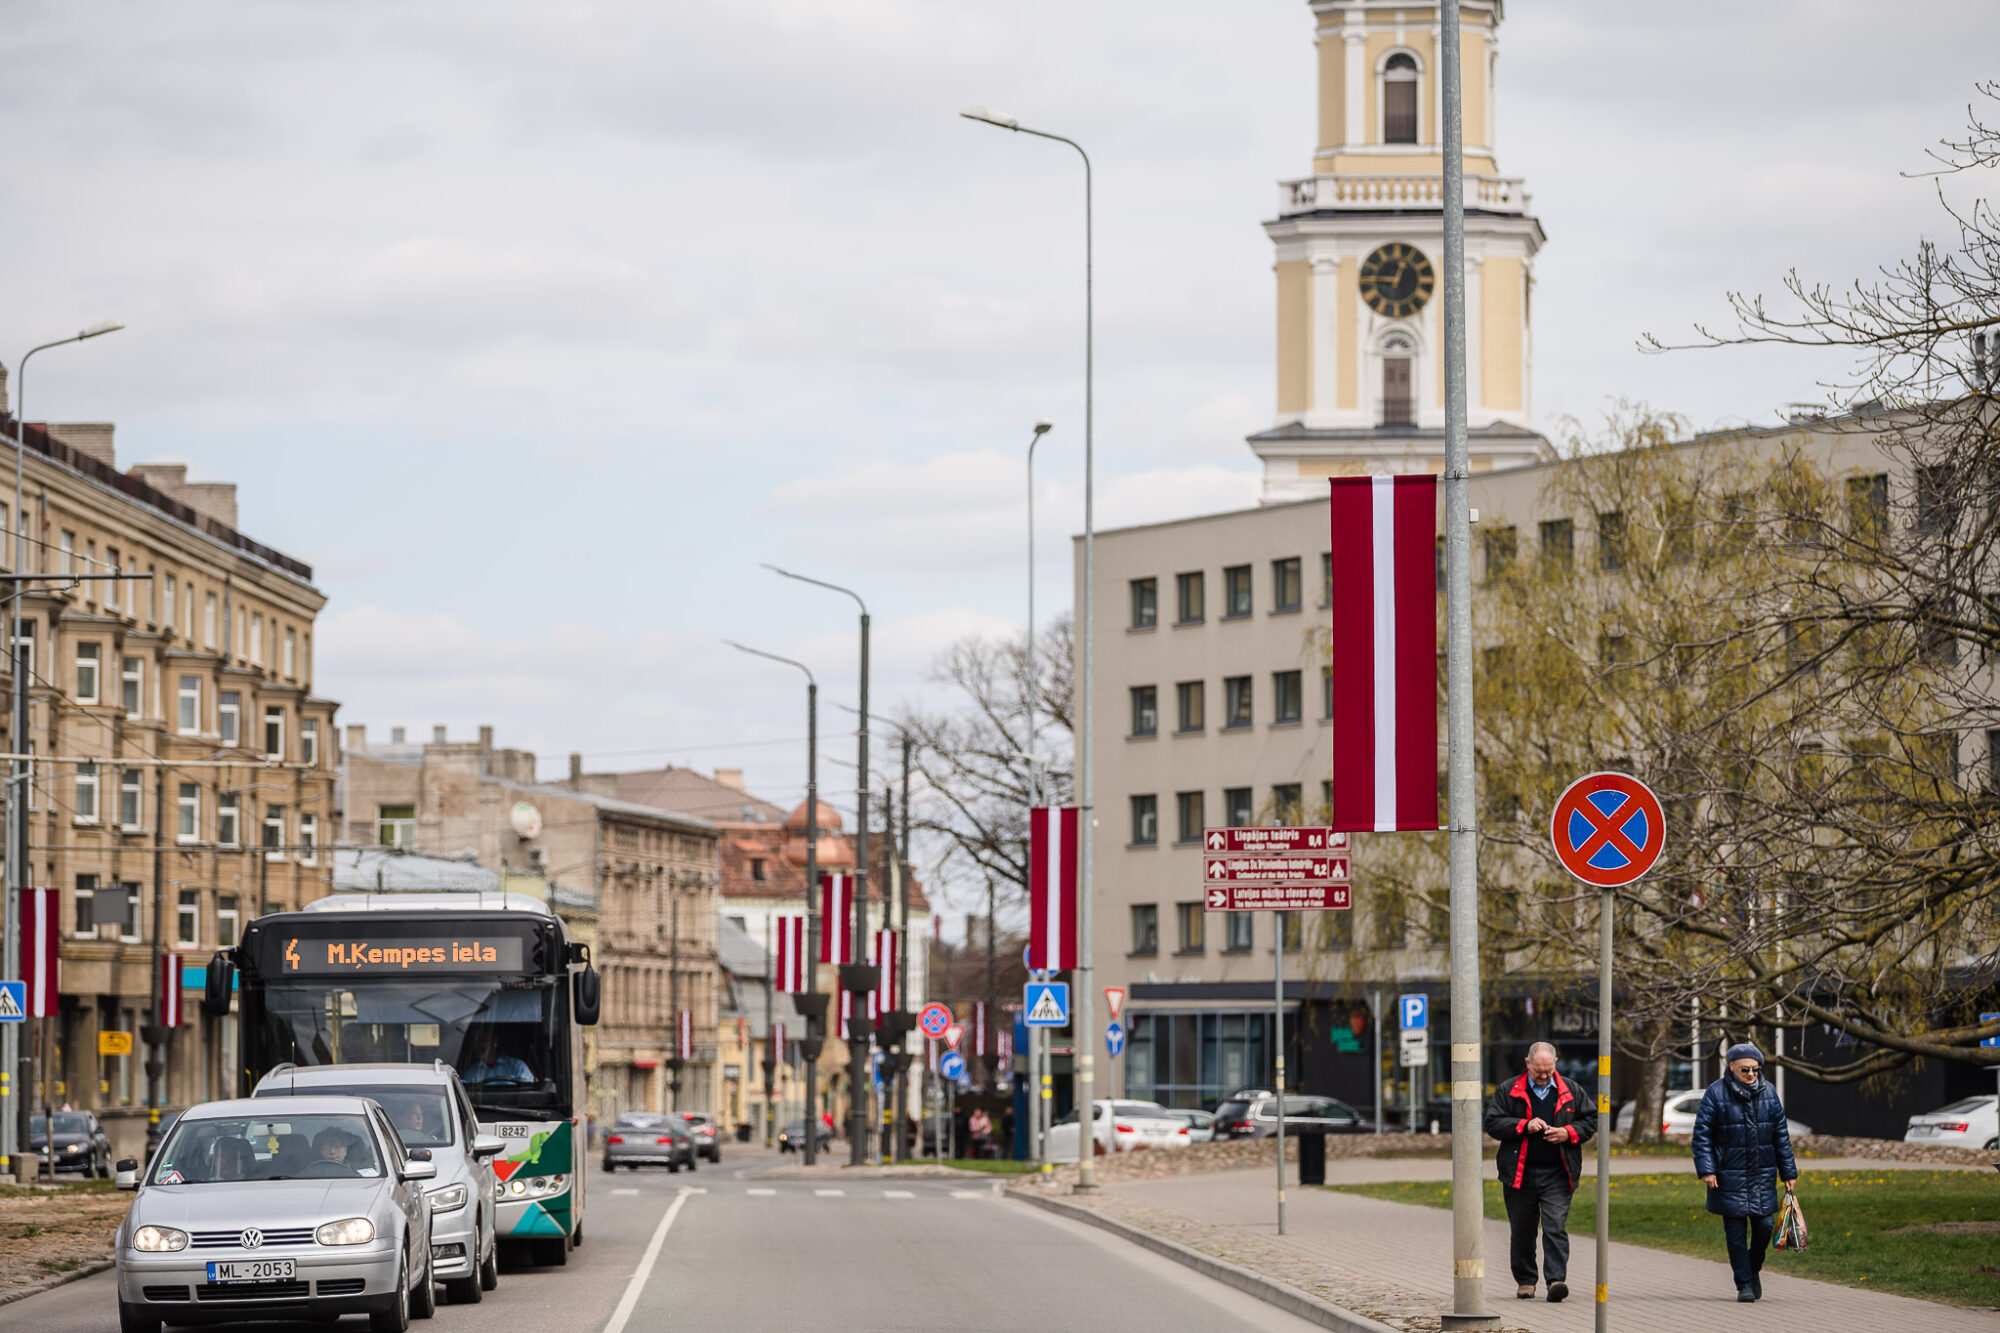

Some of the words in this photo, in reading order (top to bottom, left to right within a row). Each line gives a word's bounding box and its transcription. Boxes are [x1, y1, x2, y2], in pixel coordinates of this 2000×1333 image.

[285, 938, 301, 971] 4
[327, 942, 446, 969] M.Ķempes
[452, 941, 497, 963] iela
[1406, 998, 1423, 1028] P
[502, 1127, 526, 1137] 8242
